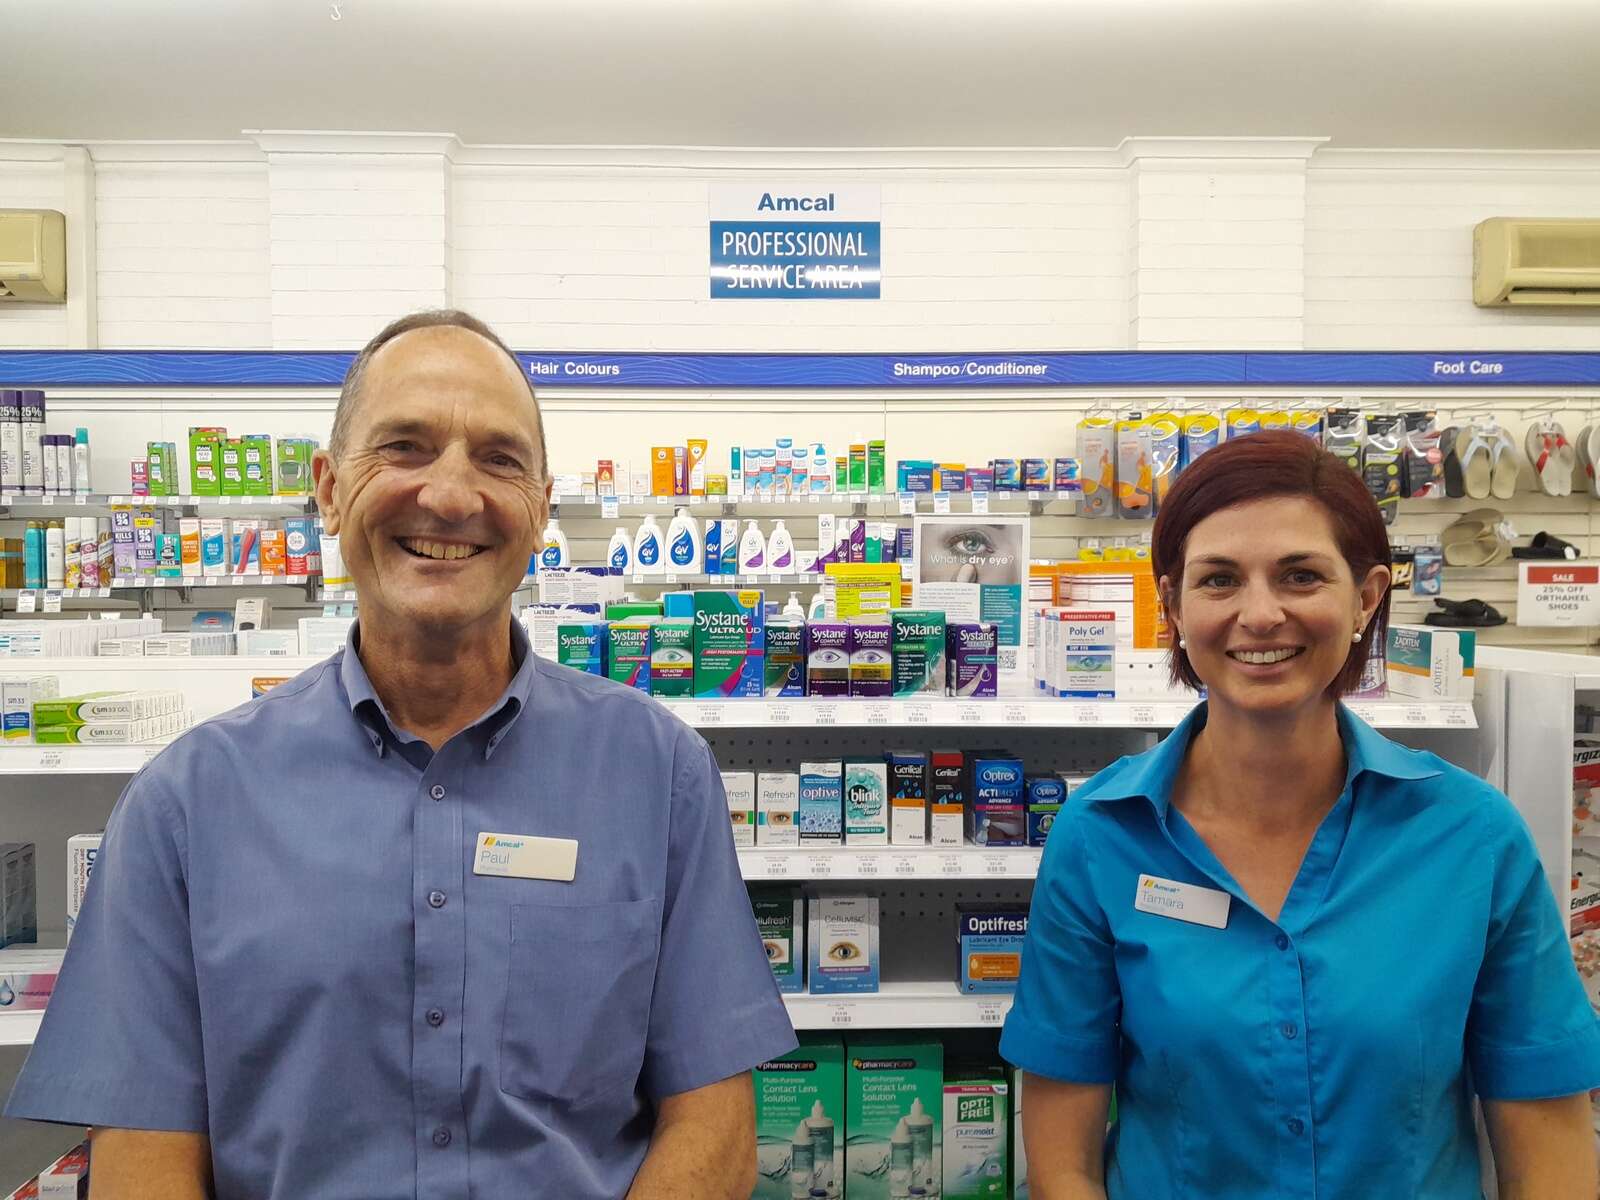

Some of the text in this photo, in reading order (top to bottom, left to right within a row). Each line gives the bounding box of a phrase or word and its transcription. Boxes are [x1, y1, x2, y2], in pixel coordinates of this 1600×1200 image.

[757, 193, 835, 211] Amcal
[722, 231, 868, 256] PROFESSIONAL
[727, 264, 863, 289] SERVICE AREA
[530, 362, 620, 375] Hair Colours
[1434, 360, 1503, 374] Foot Care
[642, 548, 654, 557] QV
[674, 546, 689, 555] QV
[707, 543, 719, 552] QV
[837, 550, 848, 558] QV
[851, 543, 865, 552] QV
[930, 554, 957, 563] What
[968, 555, 986, 565] dry
[989, 555, 1014, 566] eye?
[1552, 573, 1575, 582] SALE
[1535, 594, 1590, 602] ORTHAHEEL
[696, 610, 748, 631] Systane
[610, 629, 649, 645] Systane
[654, 627, 689, 643] Systane
[767, 630, 801, 644] Systane
[812, 628, 847, 643] Systane
[854, 628, 889, 644] Systane
[896, 622, 942, 641] Systane
[960, 630, 995, 644] Systane
[1069, 626, 1105, 637] Poly Gel
[560, 634, 596, 648] Systane
[983, 770, 1016, 783] Optrex
[726, 790, 750, 798] fresh
[763, 790, 796, 799] Refresh
[802, 786, 839, 801] optive
[851, 788, 881, 802] blink
[1036, 786, 1058, 796] Optrex
[481, 850, 510, 864] Paul
[1143, 891, 1184, 910] Tamara
[758, 916, 790, 925] llufresh
[763, 1061, 814, 1070] pharmacycare
[862, 1060, 913, 1069] pharmacycare
[763, 1085, 818, 1093] Contact Lens
[862, 1083, 917, 1092] Contact Lens
[763, 1094, 797, 1103] Solution
[862, 1093, 896, 1102] Solution
[960, 1098, 990, 1111] OPTI-
[960, 1106, 991, 1121] FREE
[956, 1127, 995, 1137] puremoist
